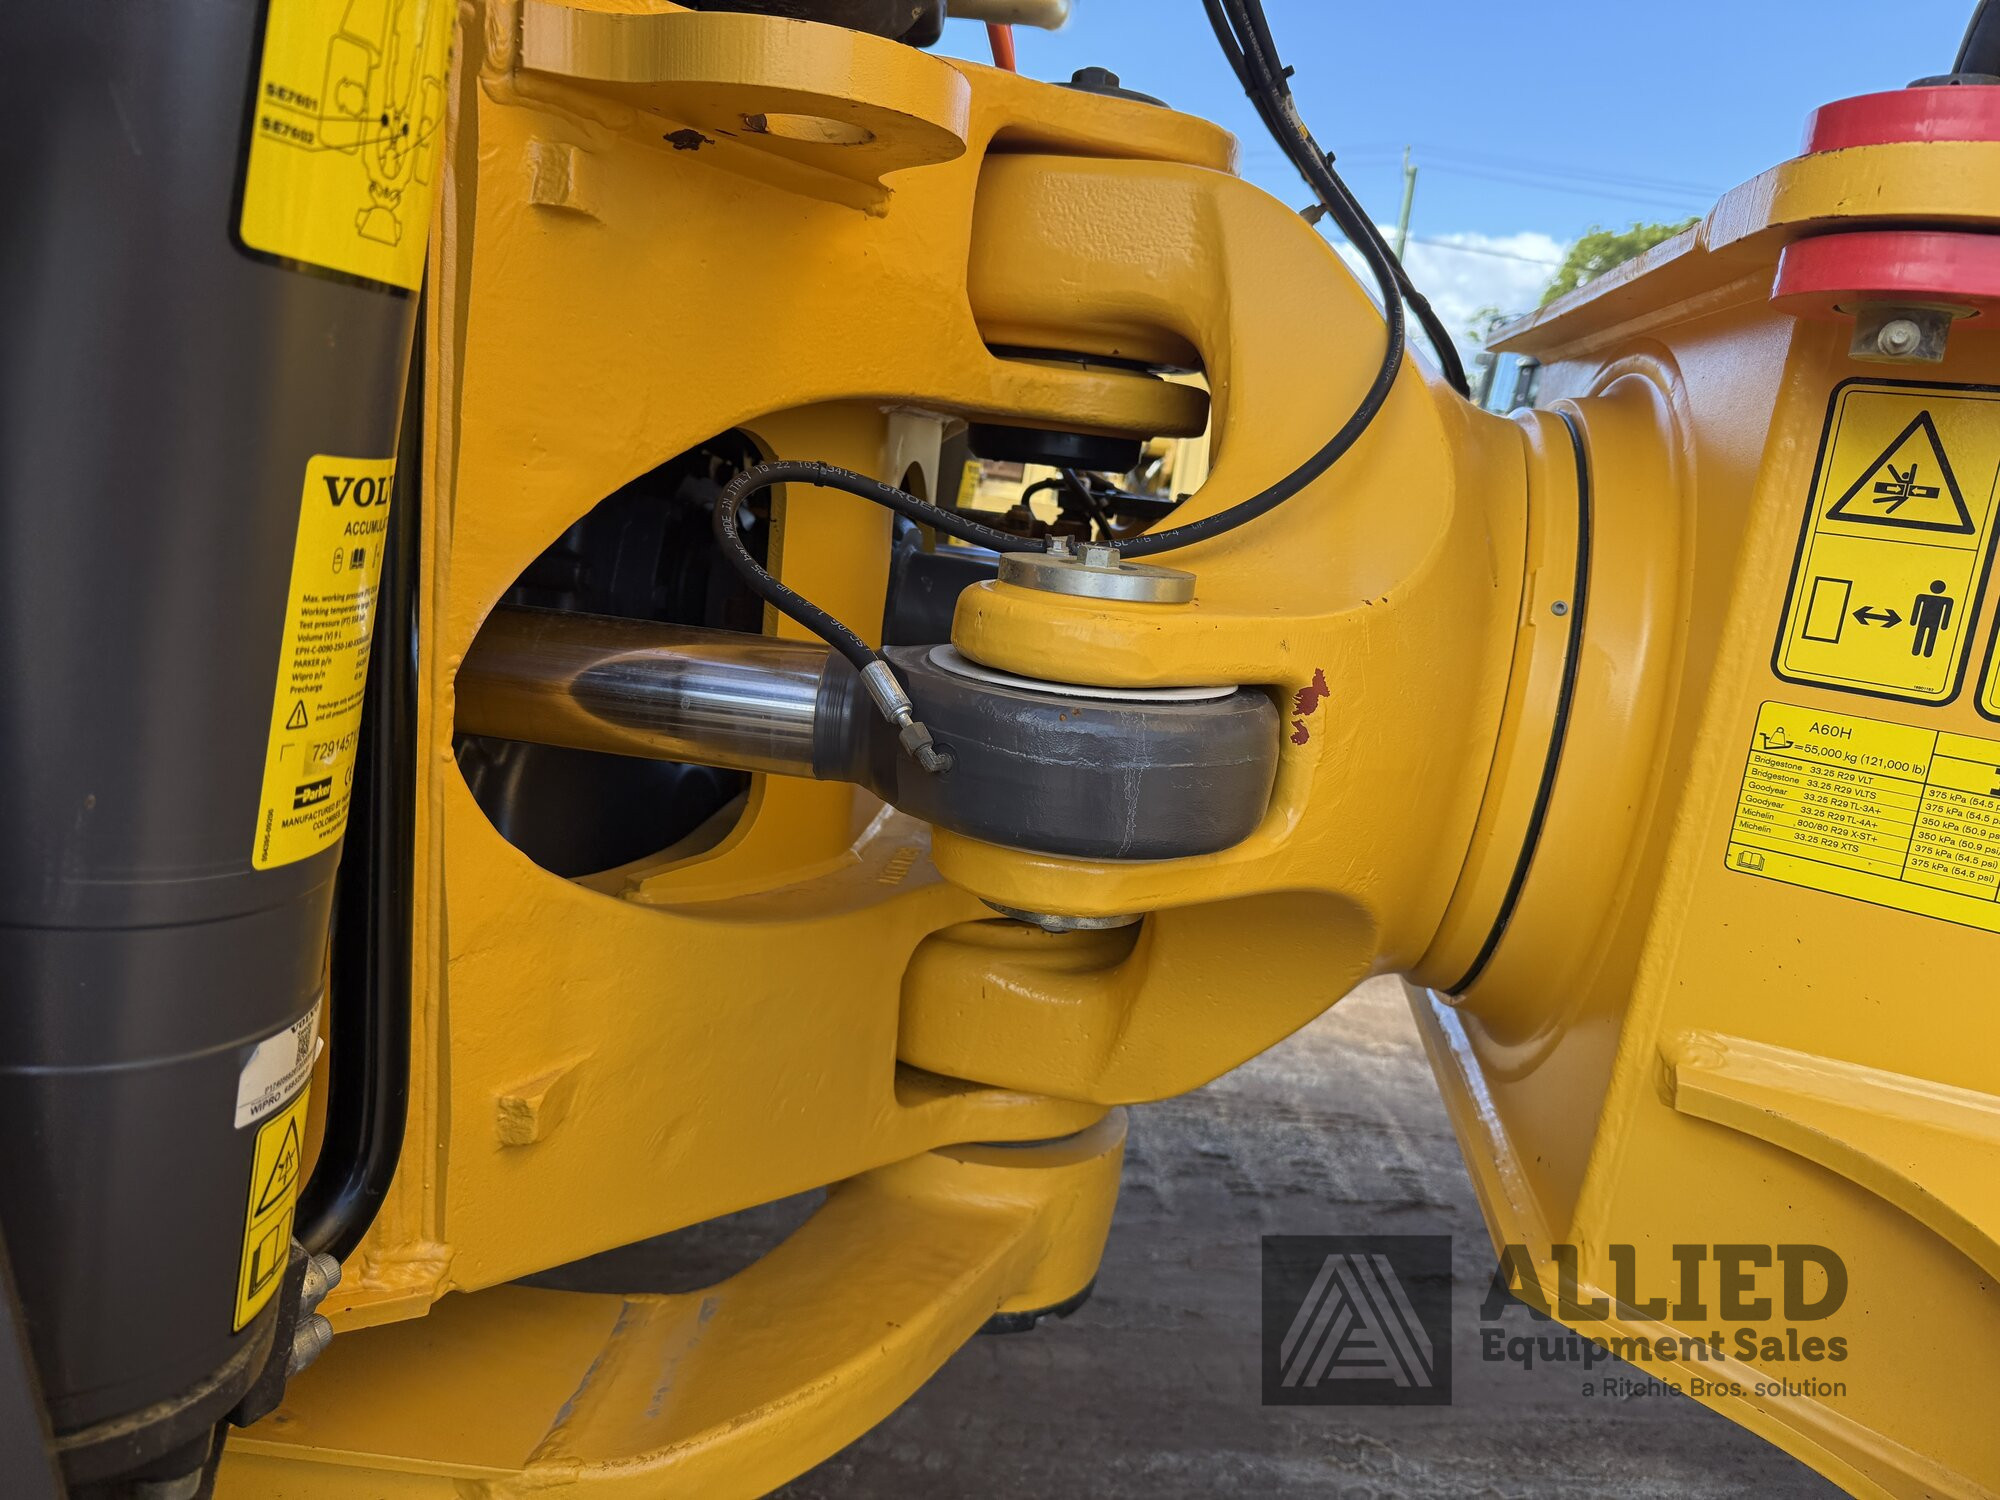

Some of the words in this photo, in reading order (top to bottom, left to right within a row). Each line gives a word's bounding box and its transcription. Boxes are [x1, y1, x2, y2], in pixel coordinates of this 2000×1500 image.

[776, 461, 791, 469] 22
[728, 471, 752, 496] ITALY
[721, 498, 733, 515] IN
[877, 482, 1018, 542] GROENEVELD
[722, 515, 736, 540] MADE
[301, 607, 329, 617] Working
[299, 621, 313, 629] Test
[314, 619, 340, 630] pressure
[297, 634, 323, 642] Volume
[293, 658, 320, 668] PARKER
[291, 672, 314, 683] Wipro
[314, 670, 326, 682] p/n
[289, 684, 323, 694] Precharge
[1809, 722, 1853, 740] A60H
[1755, 755, 1802, 771] Bridgestone
[1810, 767, 1835, 777] 33.25
[1837, 771, 1855, 781] R29
[1858, 775, 1874, 785] VLT
[1844, 751, 1857, 764] kg
[1860, 753, 1909, 772] (121,000
[1912, 764, 1926, 776] lb)
[302, 784, 331, 804] Parker
[1751, 768, 1799, 784] Bridgestone
[1806, 780, 1832, 790] 33.25
[1833, 784, 1852, 794] R29
[1854, 789, 1877, 800] VLTS
[1748, 781, 1788, 795] Goodyear
[1803, 793, 1828, 804] 33.25
[1830, 798, 1849, 808] R29
[1850, 802, 1882, 815] TL-3A+
[1928, 789, 1947, 799] 375
[1949, 793, 1966, 803] kPa
[1969, 797, 1994, 808] (54.5
[1745, 794, 1784, 808] Goodyear
[1800, 806, 1825, 817] 33.25
[1827, 811, 1845, 821] R29
[1847, 816, 1878, 829] TL-4A+
[1925, 803, 1944, 813] 375
[1946, 807, 1963, 817] kPa
[1966, 811, 1990, 822] (54.5
[1742, 807, 1774, 820] Michelin
[1797, 819, 1828, 832] 800/80
[1830, 826, 1849, 836] R29
[1850, 830, 1878, 843] X-ST+
[1921, 817, 1940, 827] 350
[1942, 821, 1959, 831] kPa
[1962, 825, 1986, 837] (50.9
[1739, 820, 1771, 833] Michelin
[1793, 832, 1819, 843] 33.25
[1820, 838, 1839, 848] R29
[1840, 842, 1859, 853] XTS
[1918, 831, 1936, 841] 350
[1938, 835, 1955, 846] kPa
[1959, 839, 1983, 851] (50.9
[1914, 844, 1933, 854] 375
[1935, 849, 1952, 859] kPa
[1955, 852, 1979, 865] (54.5
[1981, 860, 1998, 870] psi)
[1911, 858, 1929, 868] 375
[1931, 862, 1948, 873] kPa
[1951, 866, 1976, 878] (54.5
[1977, 874, 1995, 884] psi)
[249, 1091, 281, 1116] WIPRO
